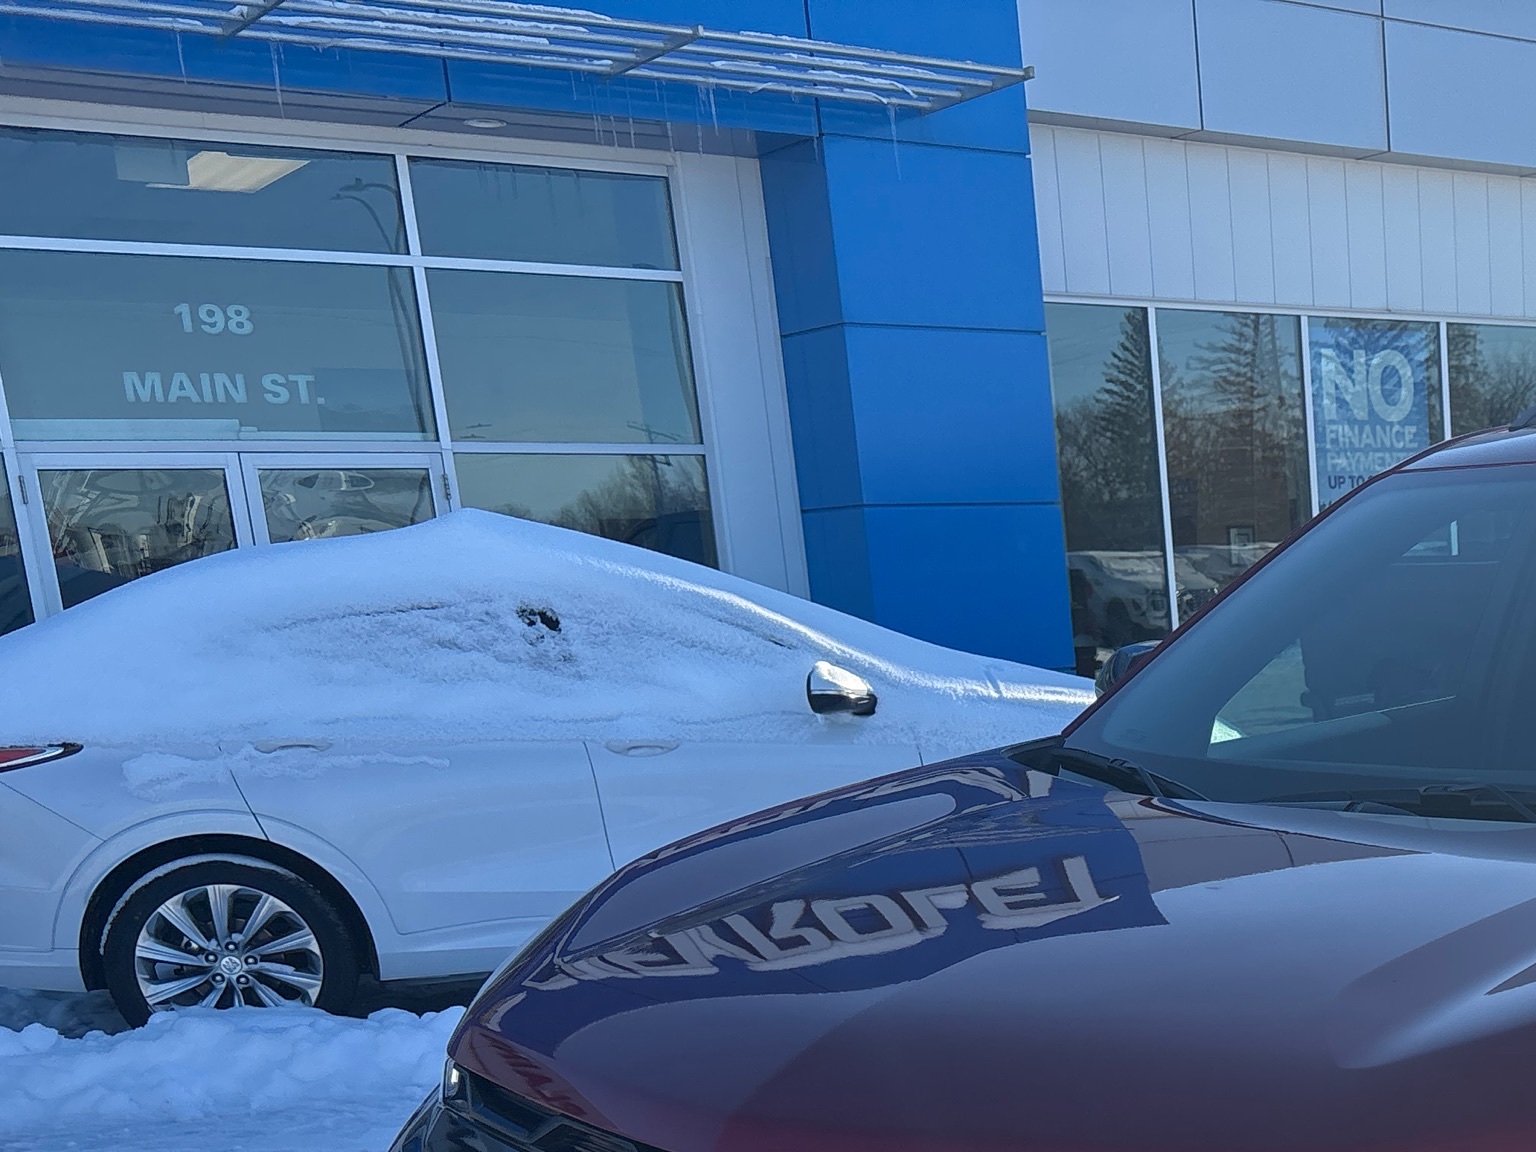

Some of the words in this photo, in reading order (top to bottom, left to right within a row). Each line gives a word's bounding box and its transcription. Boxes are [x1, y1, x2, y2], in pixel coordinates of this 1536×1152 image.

[174, 303, 254, 335] 198
[122, 371, 248, 404] MAIN
[261, 373, 326, 405] ST.
[1320, 348, 1414, 422] NO
[1325, 424, 1418, 449] FINANCE
[1328, 475, 1346, 490] UP
